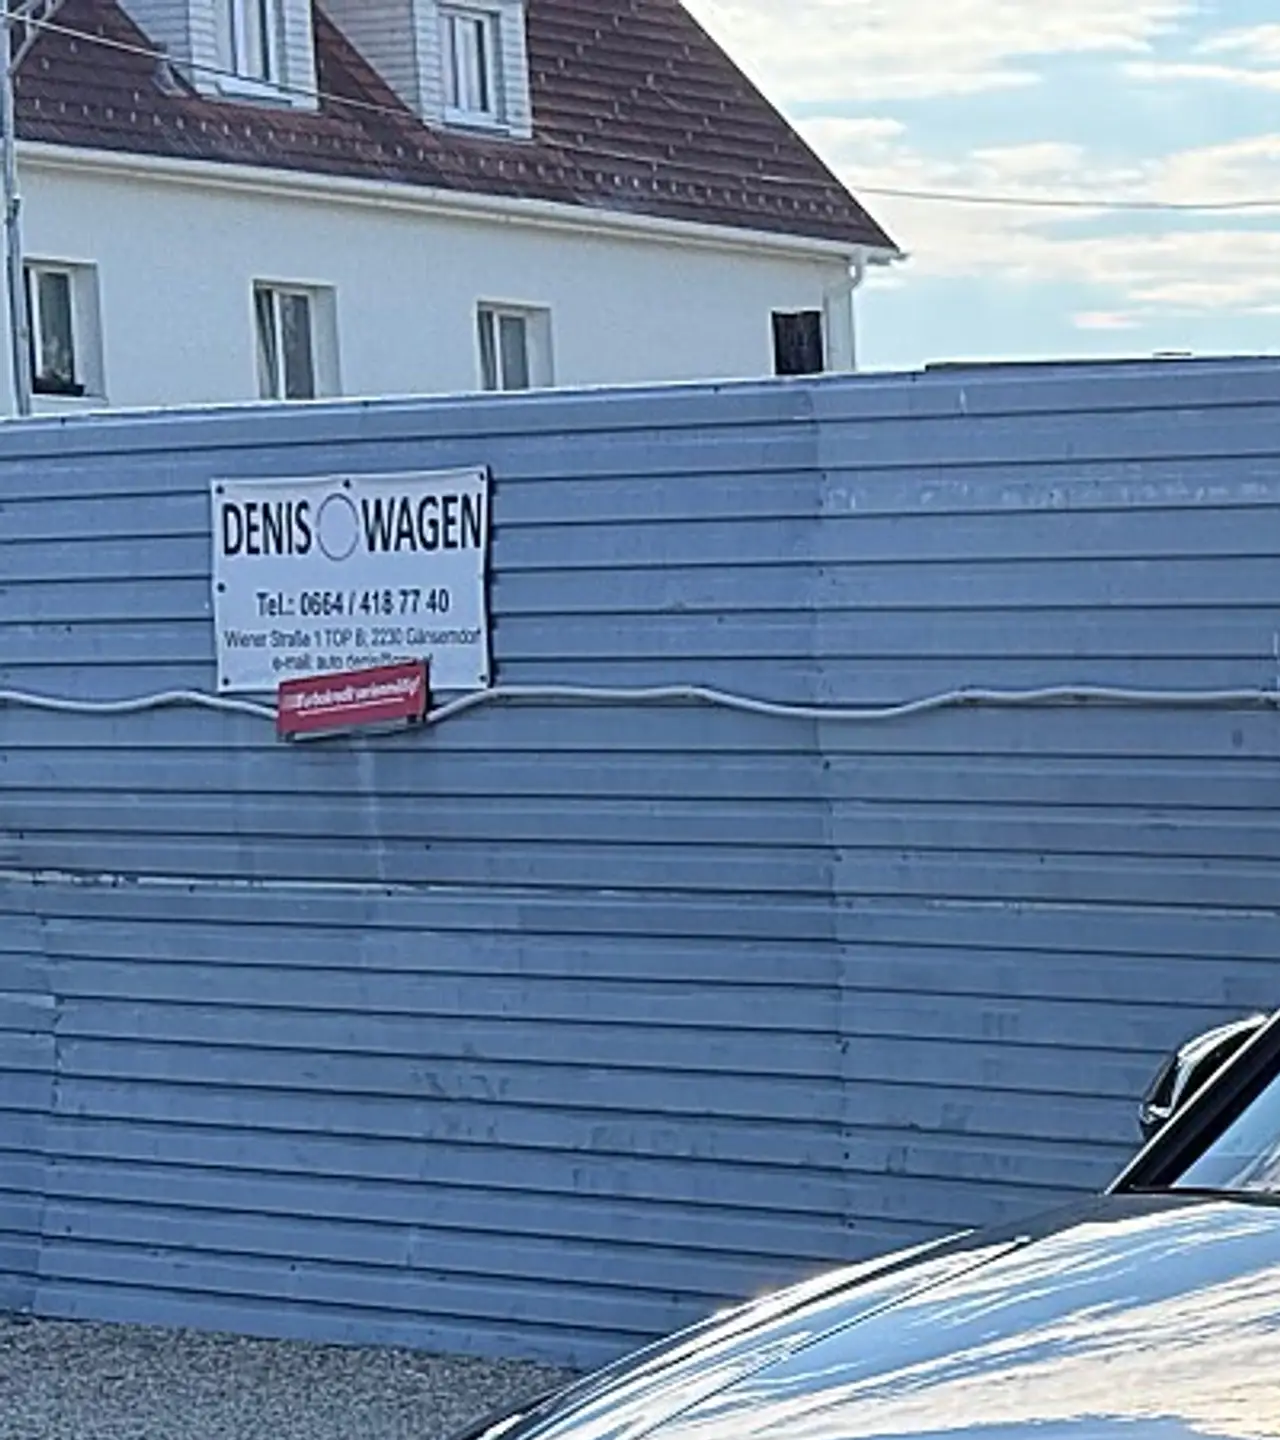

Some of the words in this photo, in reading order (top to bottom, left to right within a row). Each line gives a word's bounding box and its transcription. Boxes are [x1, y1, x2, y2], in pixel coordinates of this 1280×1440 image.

[222, 500, 312, 556] DENIS
[361, 493, 482, 552] WAGEN
[300, 590, 343, 616] 0664
[359, 589, 395, 615] 418
[399, 588, 422, 614] 77
[426, 588, 449, 613] 40
